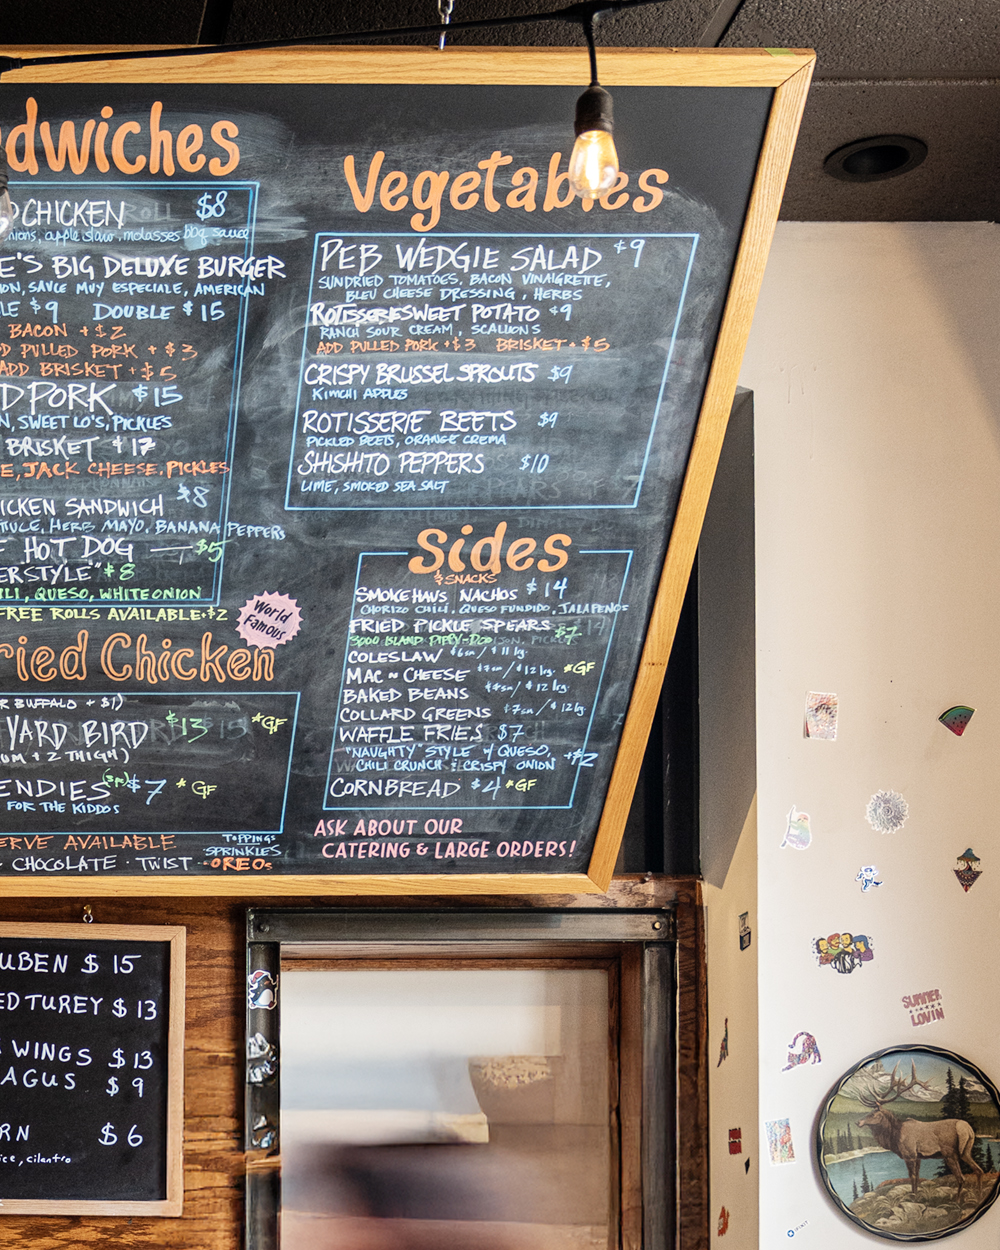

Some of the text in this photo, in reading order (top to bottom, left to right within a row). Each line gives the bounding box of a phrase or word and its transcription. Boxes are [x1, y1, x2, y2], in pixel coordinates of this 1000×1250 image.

[343, 150, 669, 231] Vegetabes
[196, 190, 228, 221] $8
[52, 256, 95, 279] BIG
[104, 255, 190, 277] DELUXE
[197, 255, 286, 279] BURGER
[321, 239, 383, 276] PEB
[396, 238, 499, 273] WEDGIE
[510, 244, 602, 274] SALAD
[304, 363, 573, 386] CRISPY BRUSSEL SPROUTS $9
[302, 410, 517, 434] ROTISSERIE BEETS
[7, 437, 100, 461] BRISKET
[298, 451, 550, 476] SHISHITO PEPPERS $10
[66, 494, 163, 517] SANDWICH
[409, 521, 572, 574] Sides
[52, 607, 100, 621] ROLLS
[252, 600, 292, 623] World
[243, 614, 286, 641] Famous
[101, 632, 275, 683] Chicken
[348, 649, 443, 664] COLESLAW
[343, 688, 469, 704] BAKED BEANS
[339, 707, 492, 722] COLLARD GREENS
[6, 714, 149, 750] YARD BIRD
[339, 723, 524, 743] WAFFLE FRIES $7
[330, 777, 461, 798] CORNBREAD
[6, 800, 35, 812] FOR
[39, 801, 66, 813] THE
[314, 818, 463, 837] ASK ABOUT OUR
[64, 835, 177, 851] AVAILABLE
[321, 840, 577, 859] CATERING & LARGE ORDERS!
[12, 855, 117, 872] CHOCOLATE
[135, 856, 193, 871] TWIST
[26, 993, 103, 1016] TUREY
[911, 1008, 944, 1026] LOVIN
[12, 1039, 93, 1067] WINGS
